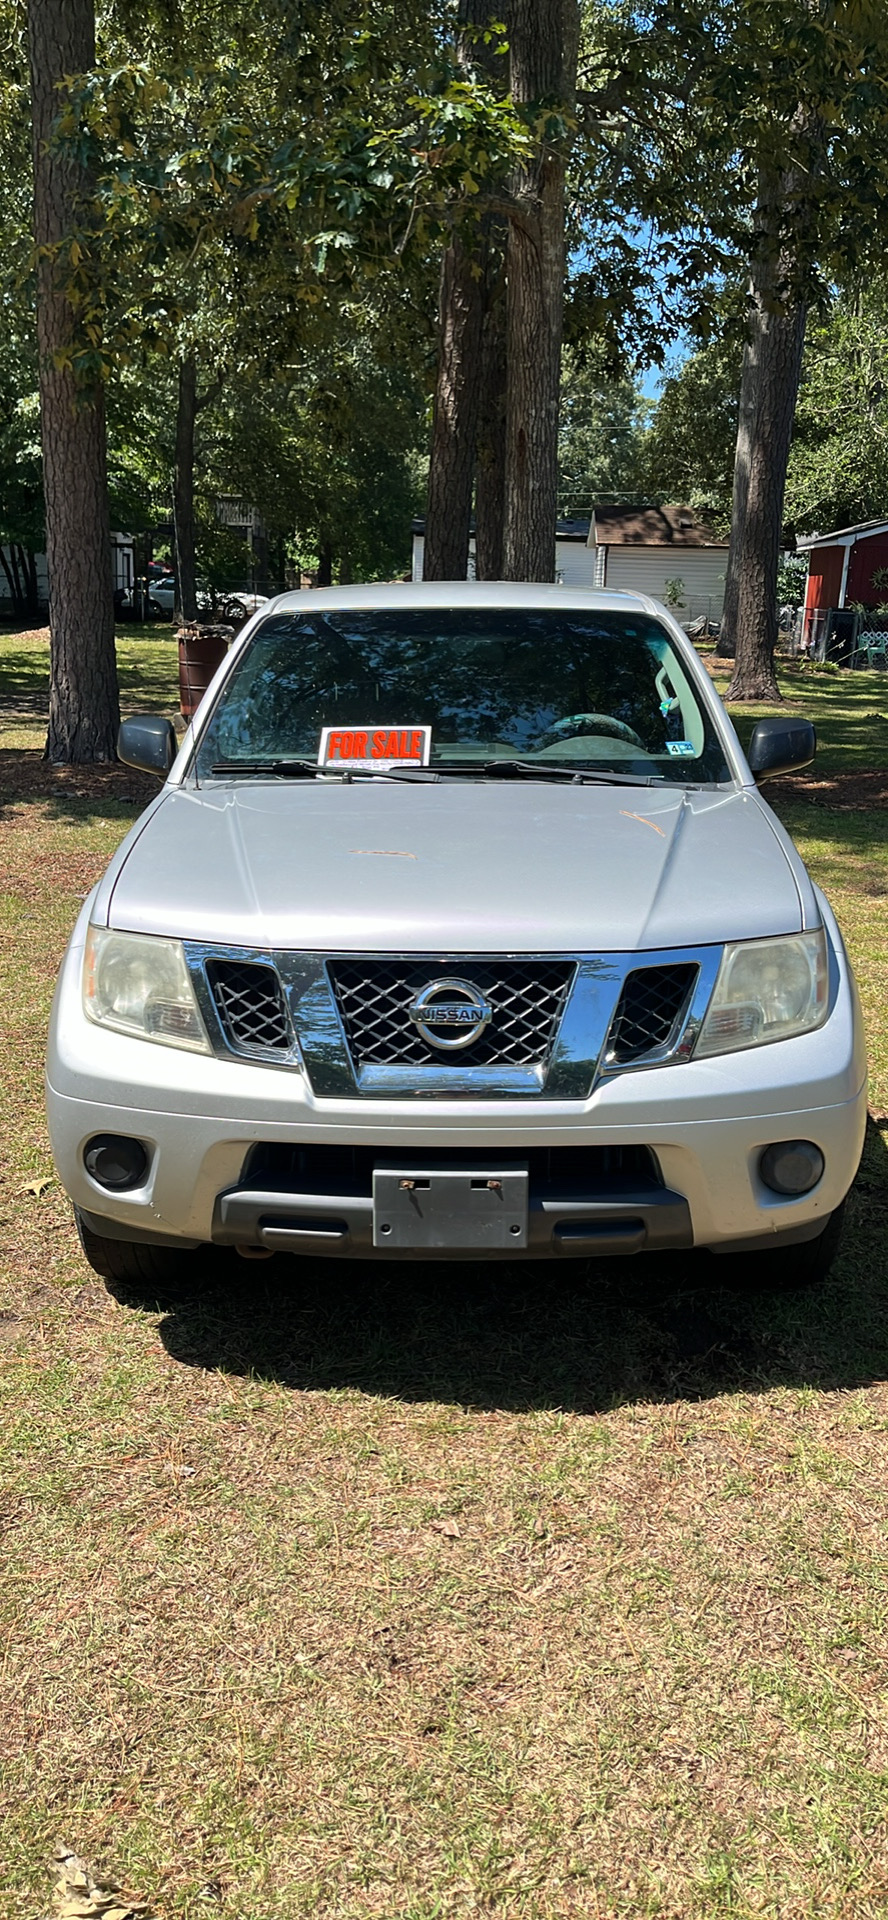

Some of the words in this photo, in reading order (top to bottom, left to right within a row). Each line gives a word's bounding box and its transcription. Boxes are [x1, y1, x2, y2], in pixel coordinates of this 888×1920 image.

[328, 731, 368, 759] FOR
[371, 730, 422, 759] SALE
[671, 745, 679, 753] 4
[421, 1009, 483, 1020] NISSAN
